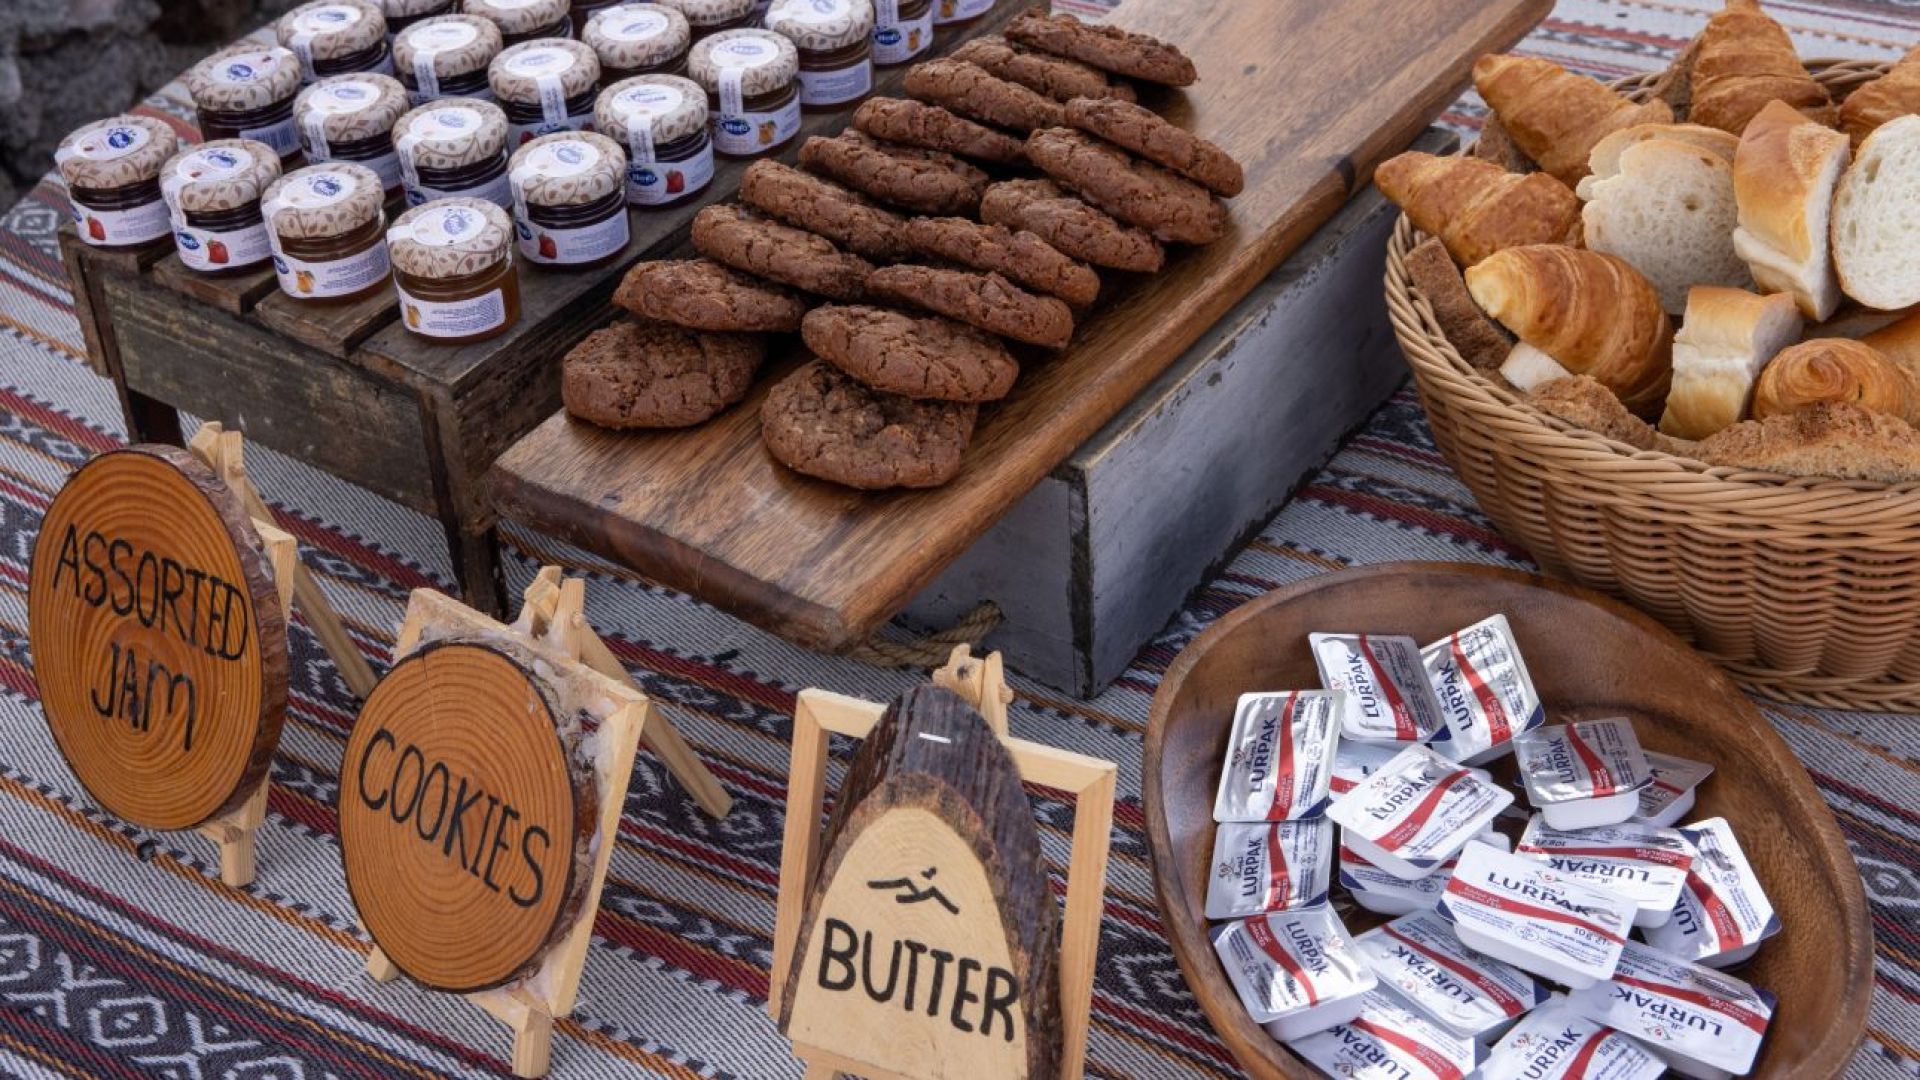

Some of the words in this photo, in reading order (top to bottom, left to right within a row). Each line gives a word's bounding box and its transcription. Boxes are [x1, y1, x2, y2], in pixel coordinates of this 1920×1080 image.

[53, 523, 248, 661] ASSORTED
[91, 641, 196, 751] JAM
[1347, 652, 1381, 718] LURPAK
[1438, 660, 1473, 732] LURPAK
[1250, 716, 1277, 793] LURPAK
[1549, 738, 1576, 785] LURPAK
[358, 727, 550, 908] COOKIES
[1371, 771, 1438, 821] LURPAK
[1242, 836, 1264, 897] LURPAK
[1487, 871, 1592, 917] LURPAK
[1549, 857, 1650, 883] LURPAK
[1286, 920, 1329, 977] LURPAK
[1394, 945, 1476, 1005] LURPAK
[818, 918, 1020, 1042] BUTTER
[1616, 986, 1723, 1037] LURPAK
[1516, 1027, 1583, 1080] URPAK
